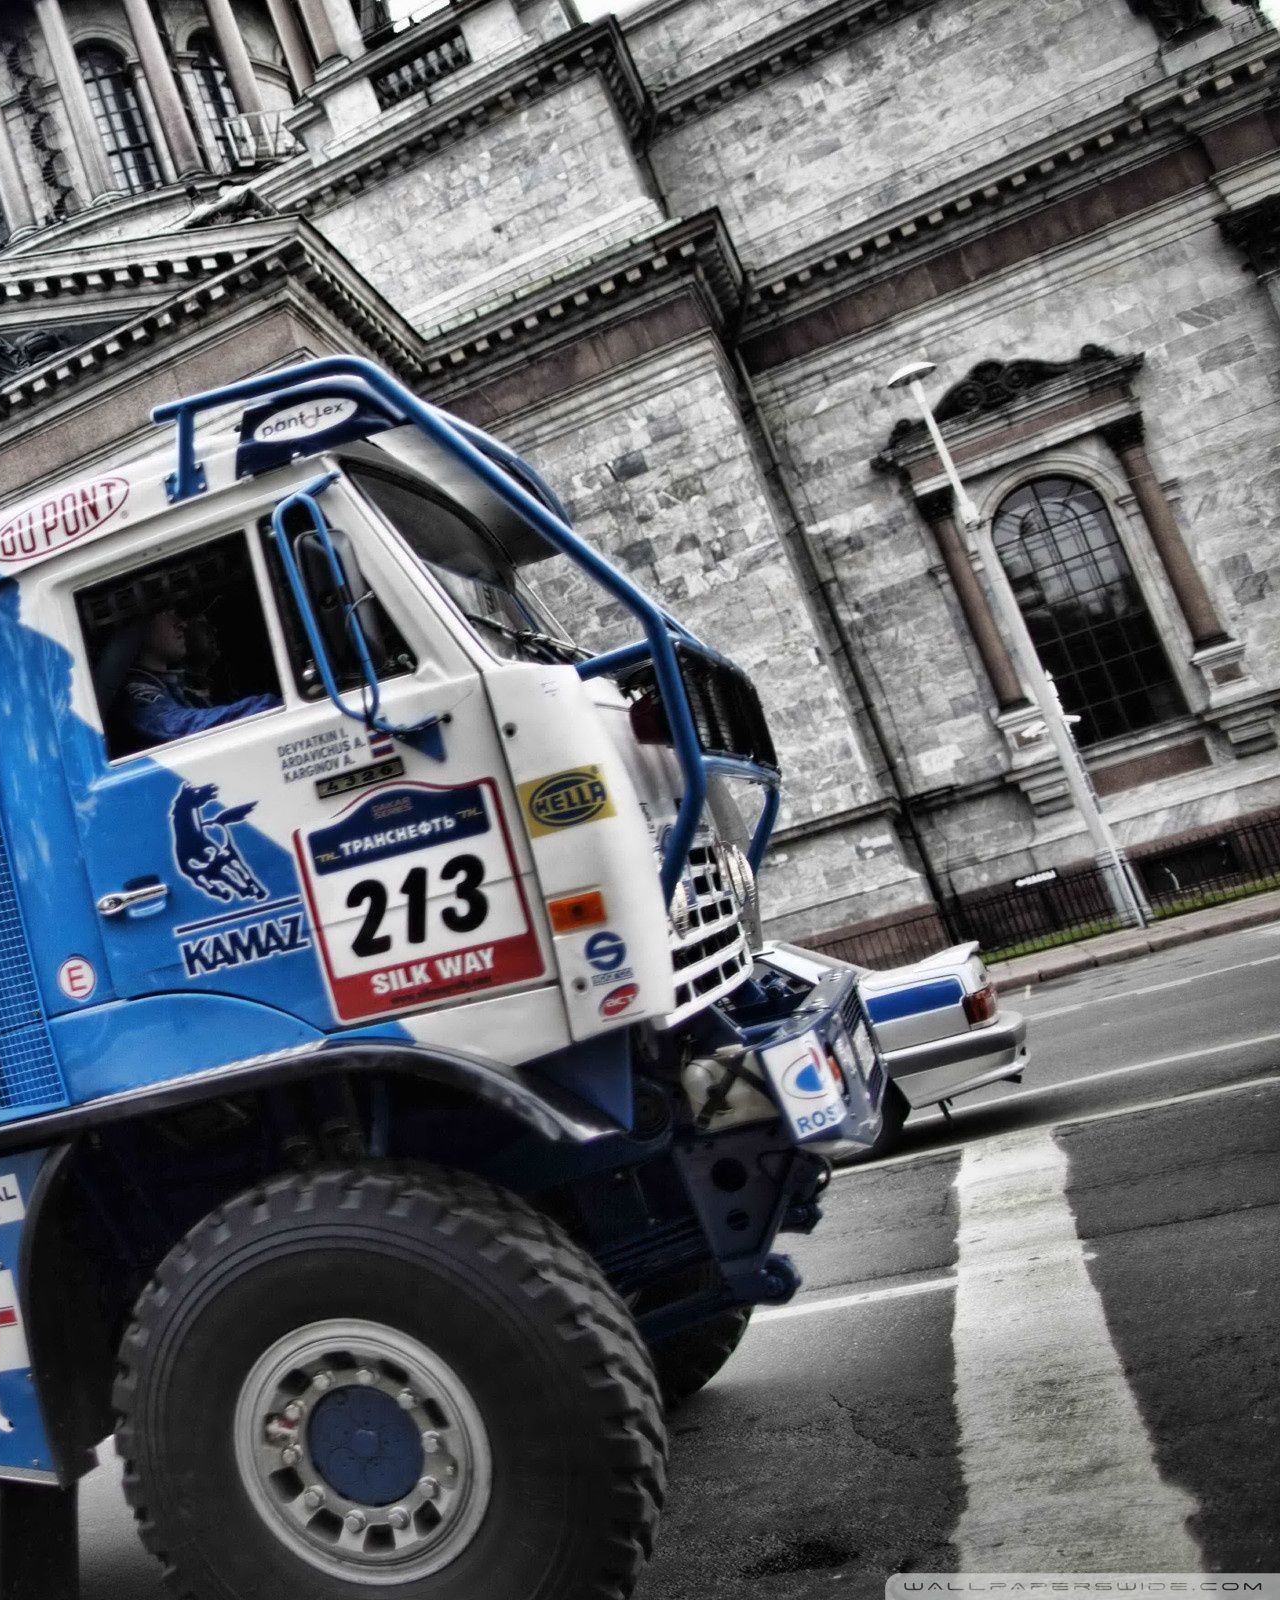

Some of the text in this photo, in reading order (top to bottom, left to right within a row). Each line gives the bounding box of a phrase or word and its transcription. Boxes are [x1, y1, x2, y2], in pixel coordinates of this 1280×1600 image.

[284, 757, 340, 783] KARGINOV
[535, 779, 607, 815] HELLA
[339, 815, 457, 858] ТРАНСНЕФТЬ
[347, 854, 489, 958] 213
[178, 913, 313, 978] KAMAZ
[67, 965, 87, 992] E
[370, 962, 432, 995] SILK
[435, 947, 494, 979] WAY
